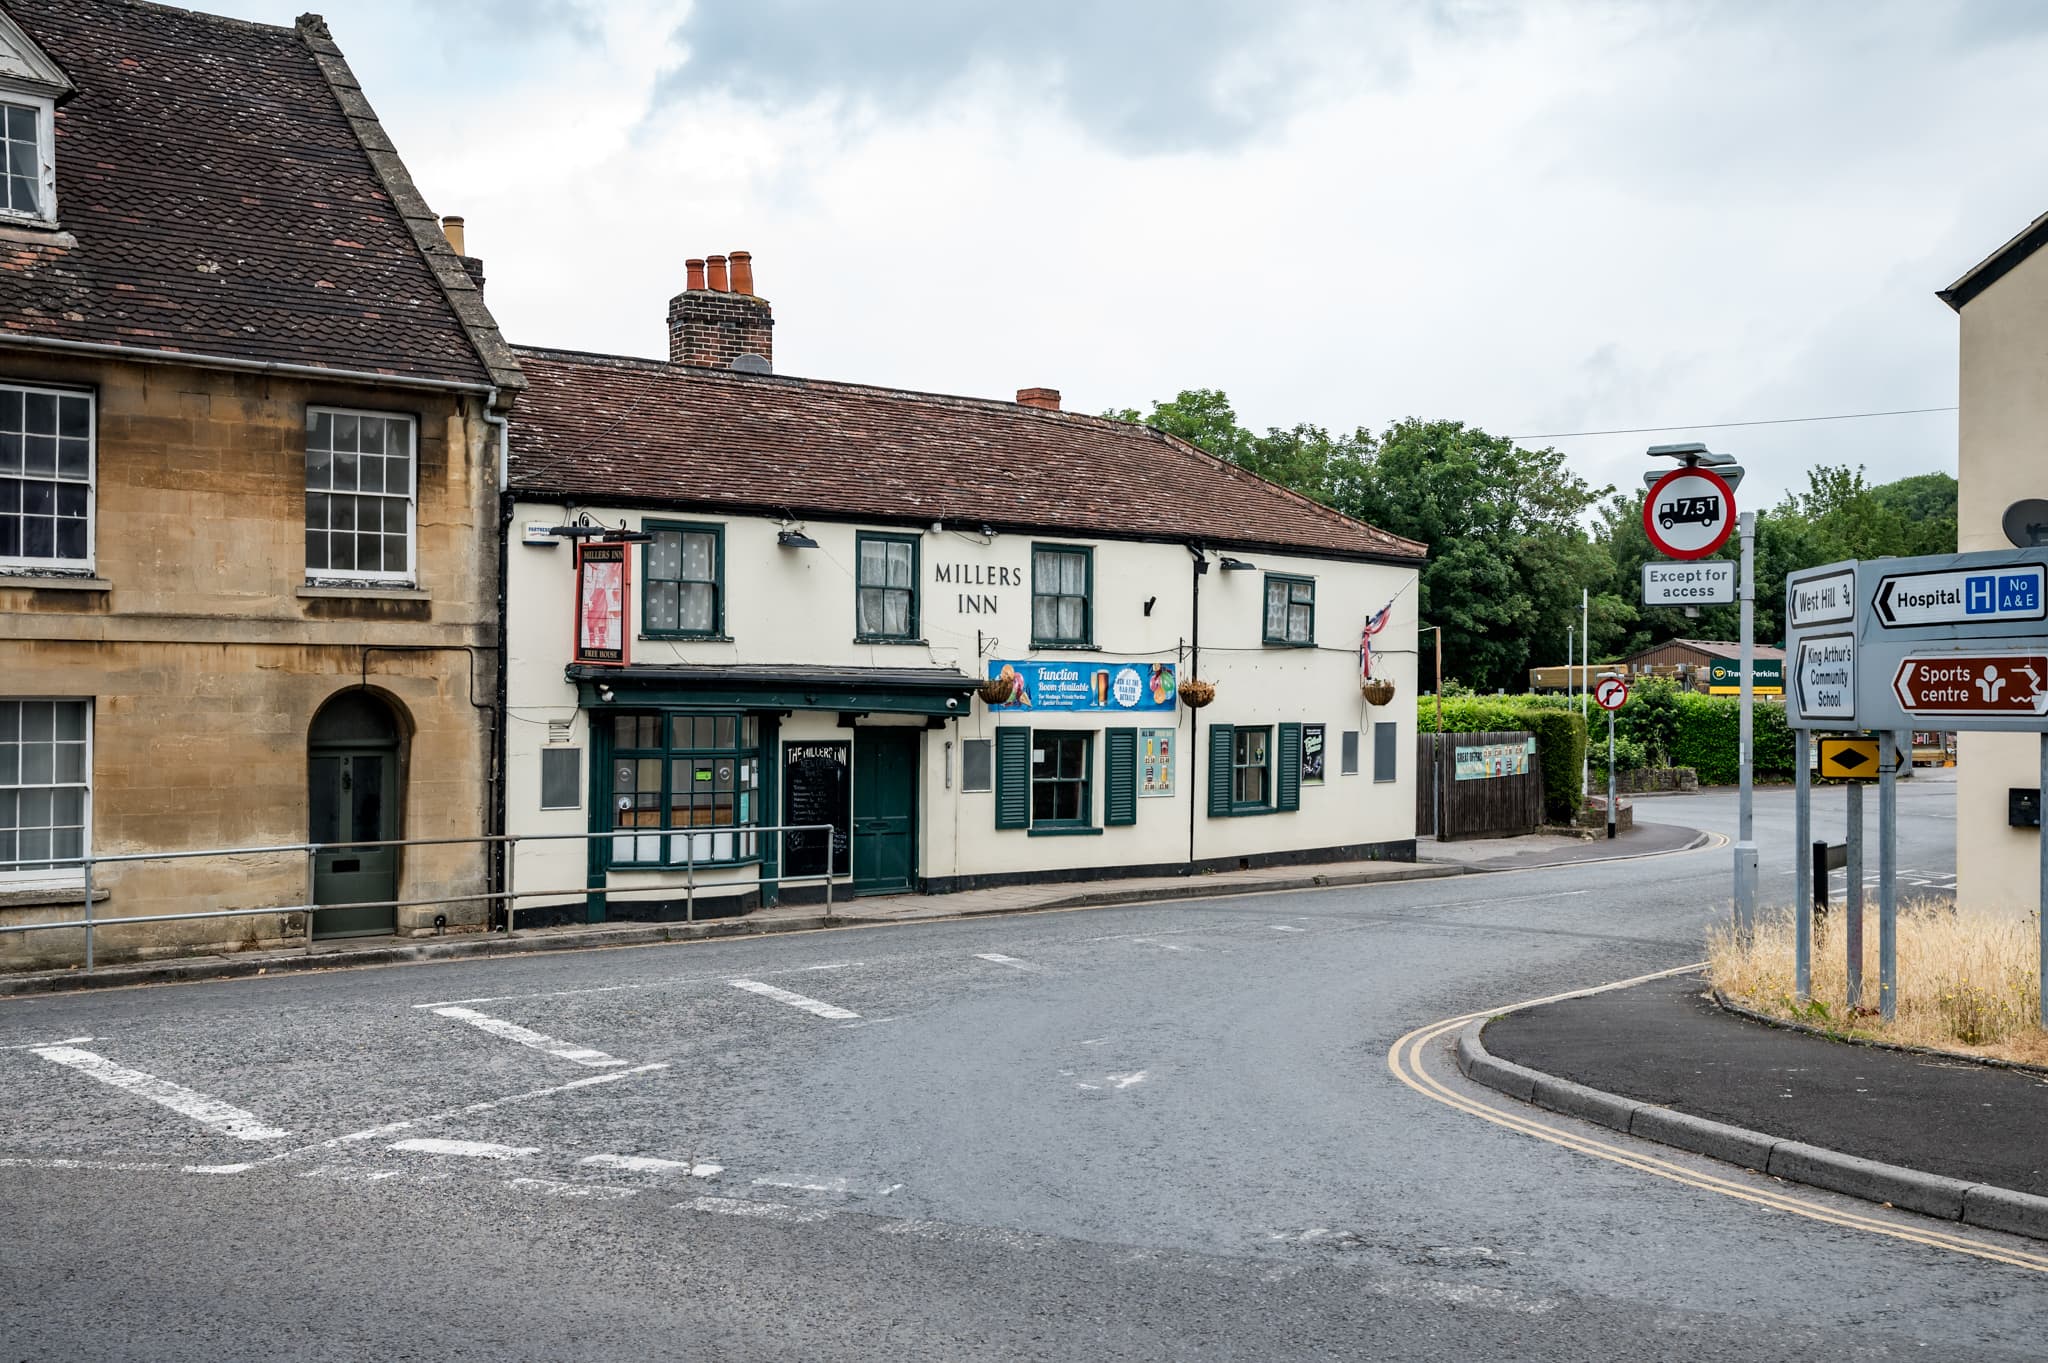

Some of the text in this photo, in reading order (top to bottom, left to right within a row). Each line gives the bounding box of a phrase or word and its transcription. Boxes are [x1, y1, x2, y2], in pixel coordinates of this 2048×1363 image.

[584, 550, 624, 560] MILLERS INN
[935, 562, 1021, 586] MILLERS
[1650, 568, 1728, 584] Except for
[1663, 586, 1715, 598] access
[2010, 578, 2028, 591] No
[1800, 591, 1819, 612] West
[1821, 586, 1836, 609] Hill
[1898, 580, 1991, 610] Hospital H
[958, 593, 998, 615] INN
[584, 649, 618, 658] FREE HOUSE
[1808, 645, 1851, 666] King Arthur's
[1038, 667, 1079, 681] Function
[1752, 670, 1779, 678] Perkins
[1810, 668, 1849, 688] Community
[1920, 665, 1971, 684] Sports
[1038, 682, 1089, 692] Room Available
[1921, 685, 1969, 702] centre
[1818, 691, 1841, 708] School
[788, 747, 802, 765] THE
